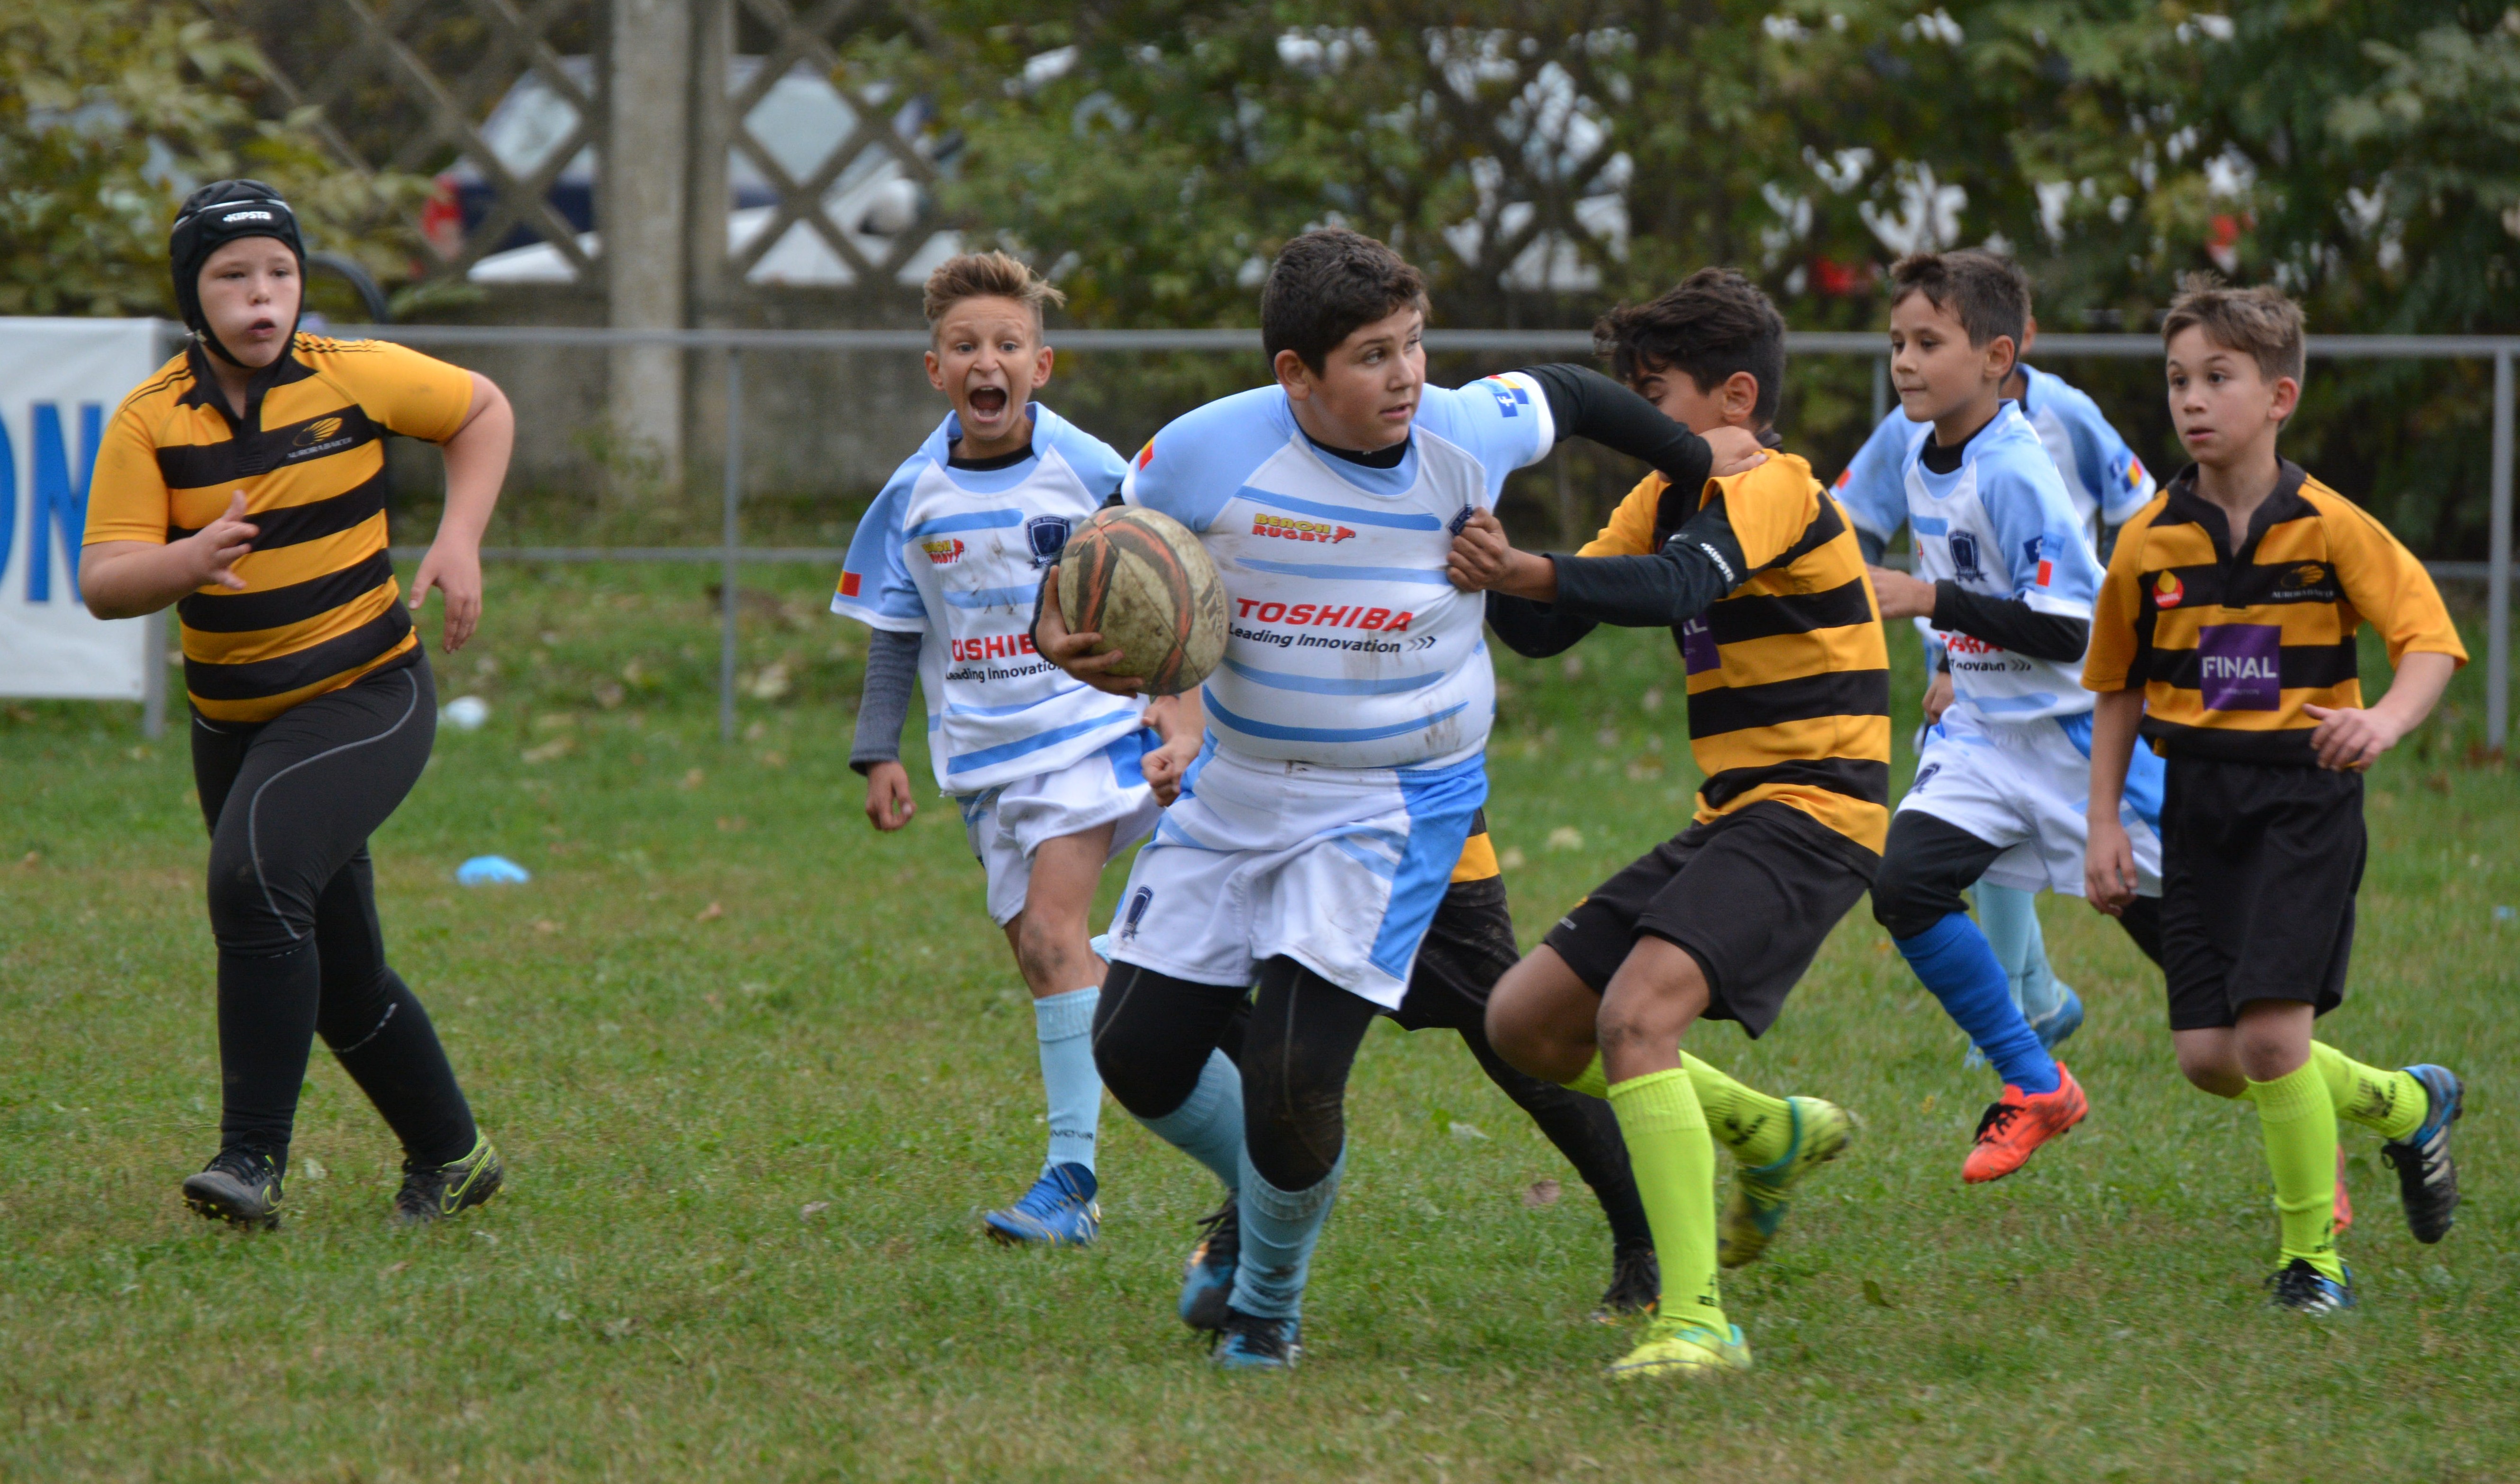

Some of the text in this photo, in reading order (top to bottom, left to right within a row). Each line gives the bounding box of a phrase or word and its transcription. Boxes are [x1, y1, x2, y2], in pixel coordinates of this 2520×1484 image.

[1252, 524, 1332, 543] RUGBY
[1254, 513, 1331, 534] BEACH
[1236, 598, 1413, 632] TOSHIBA
[1229, 622, 1401, 653] Leading Innovation
[987, 660, 1061, 680] Innovatio
[2202, 656, 2277, 679] FINAL
